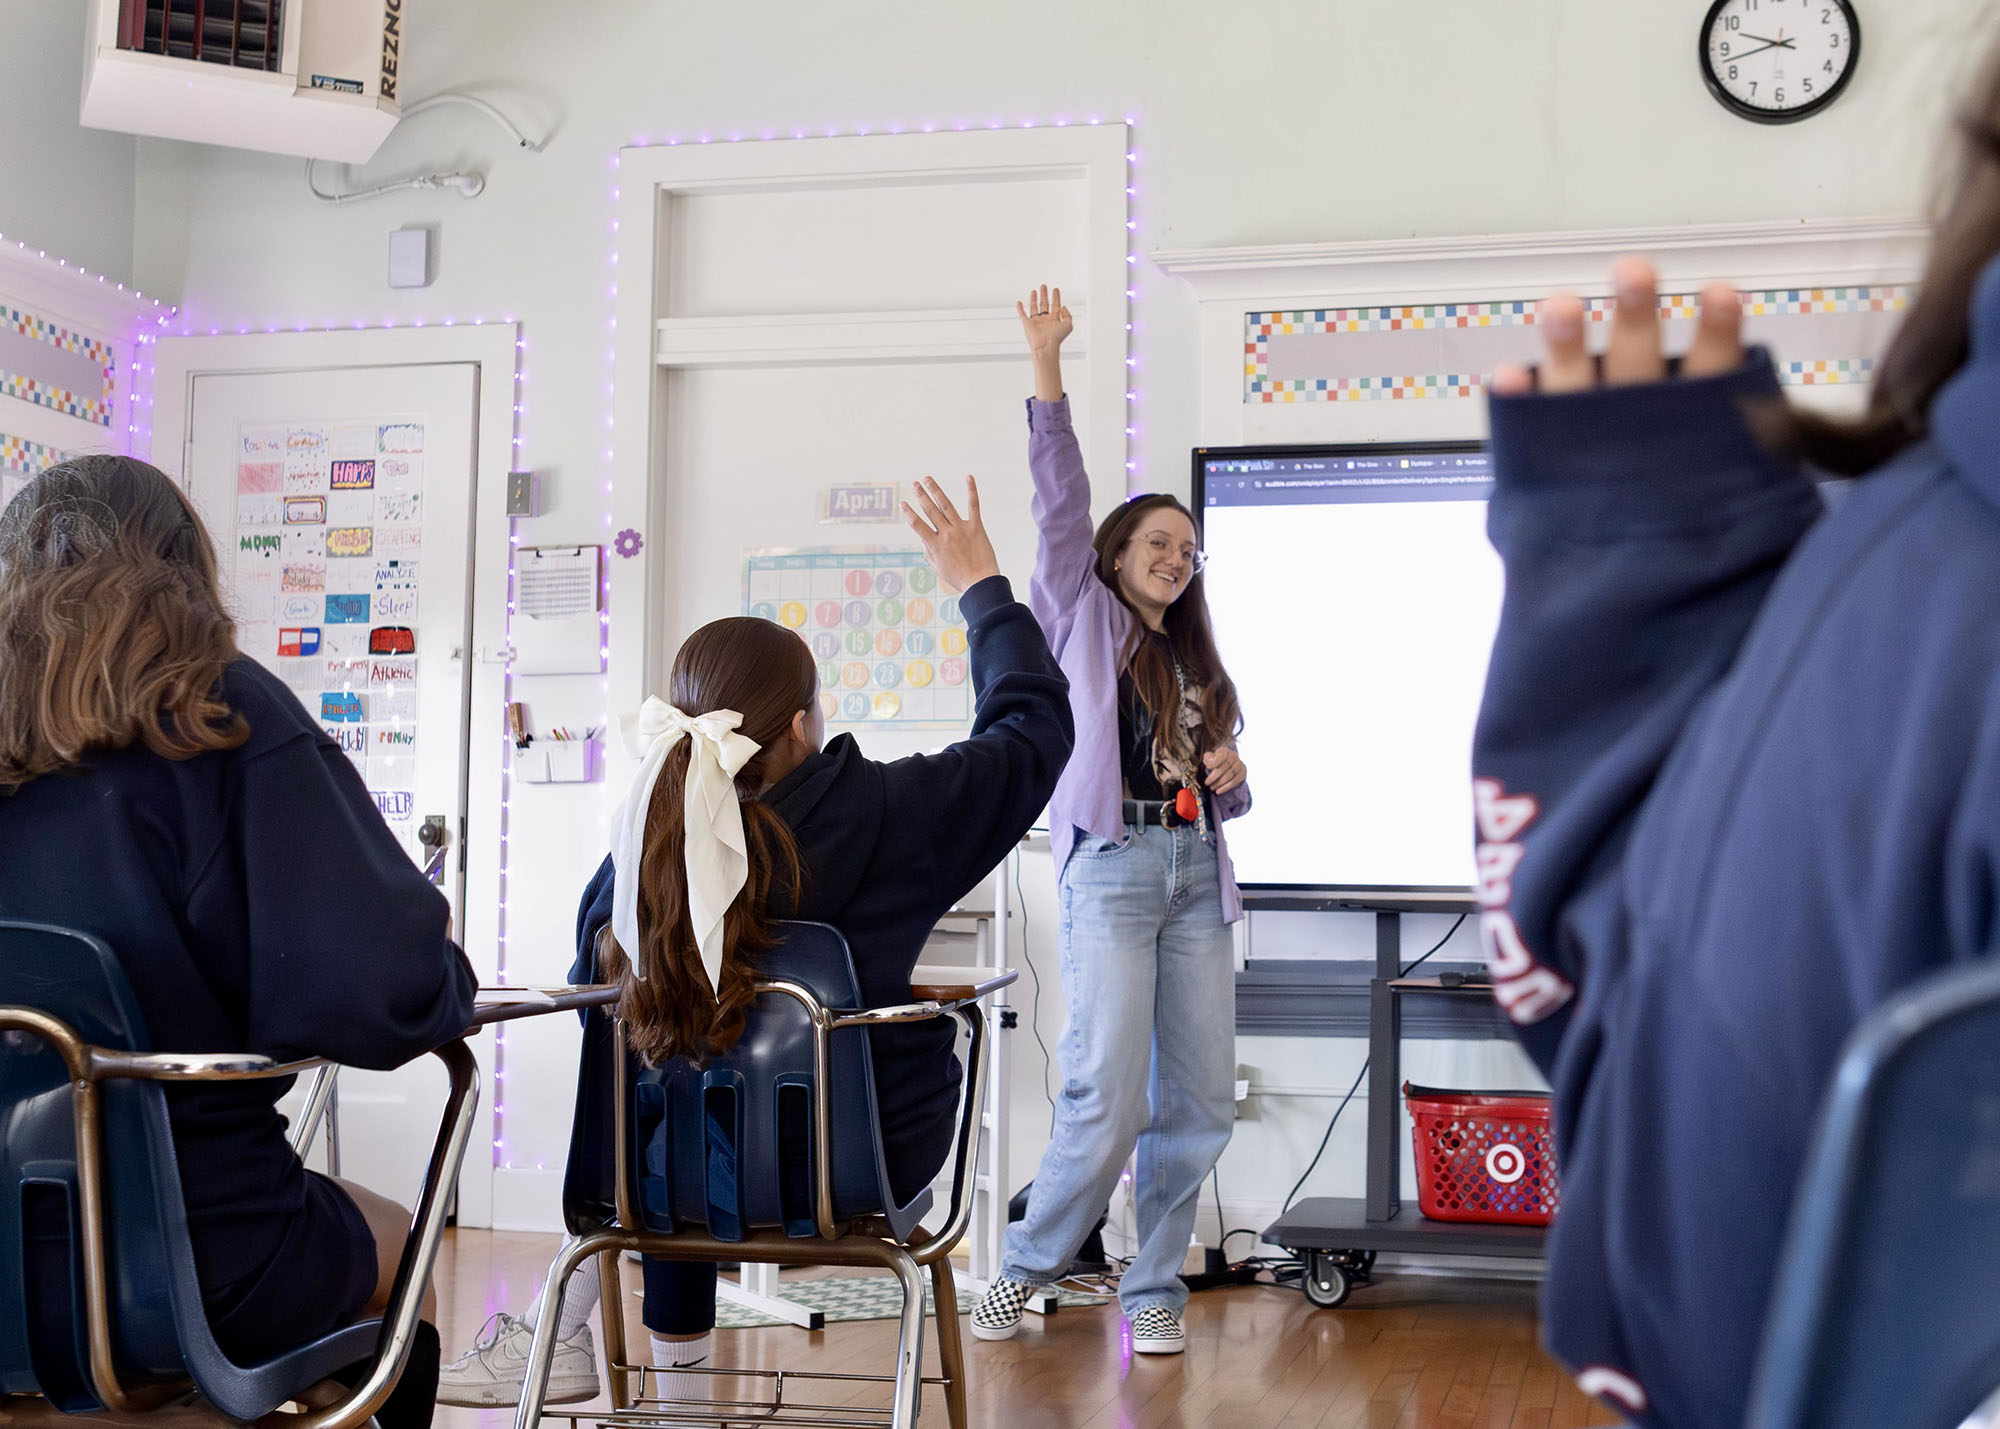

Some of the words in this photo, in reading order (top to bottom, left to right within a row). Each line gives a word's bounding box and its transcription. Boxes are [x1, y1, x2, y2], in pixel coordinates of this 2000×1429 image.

[1724, 15, 1740, 31] 10
[1821, 8, 1831, 24] 2
[1720, 42, 1730, 56] 9
[1830, 33, 1839, 48] 3
[1728, 65, 1738, 80] 8
[1823, 59, 1833, 74] 4
[1748, 81, 1758, 97] 7
[1803, 78, 1813, 92] 5
[1775, 87, 1784, 102] 6
[333, 462, 374, 483] HAPPY
[834, 489, 888, 514] April
[854, 571, 861, 593] 1
[883, 573, 892, 593] 2
[378, 596, 413, 616] Sleep
[788, 604, 796, 624] 6
[823, 604, 832, 624] 7
[852, 603, 861, 623] 8
[884, 601, 893, 621] 9
[818, 635, 831, 655] 14
[851, 632, 865, 653] 15
[879, 633, 893, 653] 16
[912, 632, 923, 652] 17
[371, 663, 413, 682] Athletic
[880, 664, 894, 684] 23
[944, 661, 960, 681] 25
[848, 695, 862, 716] 29
